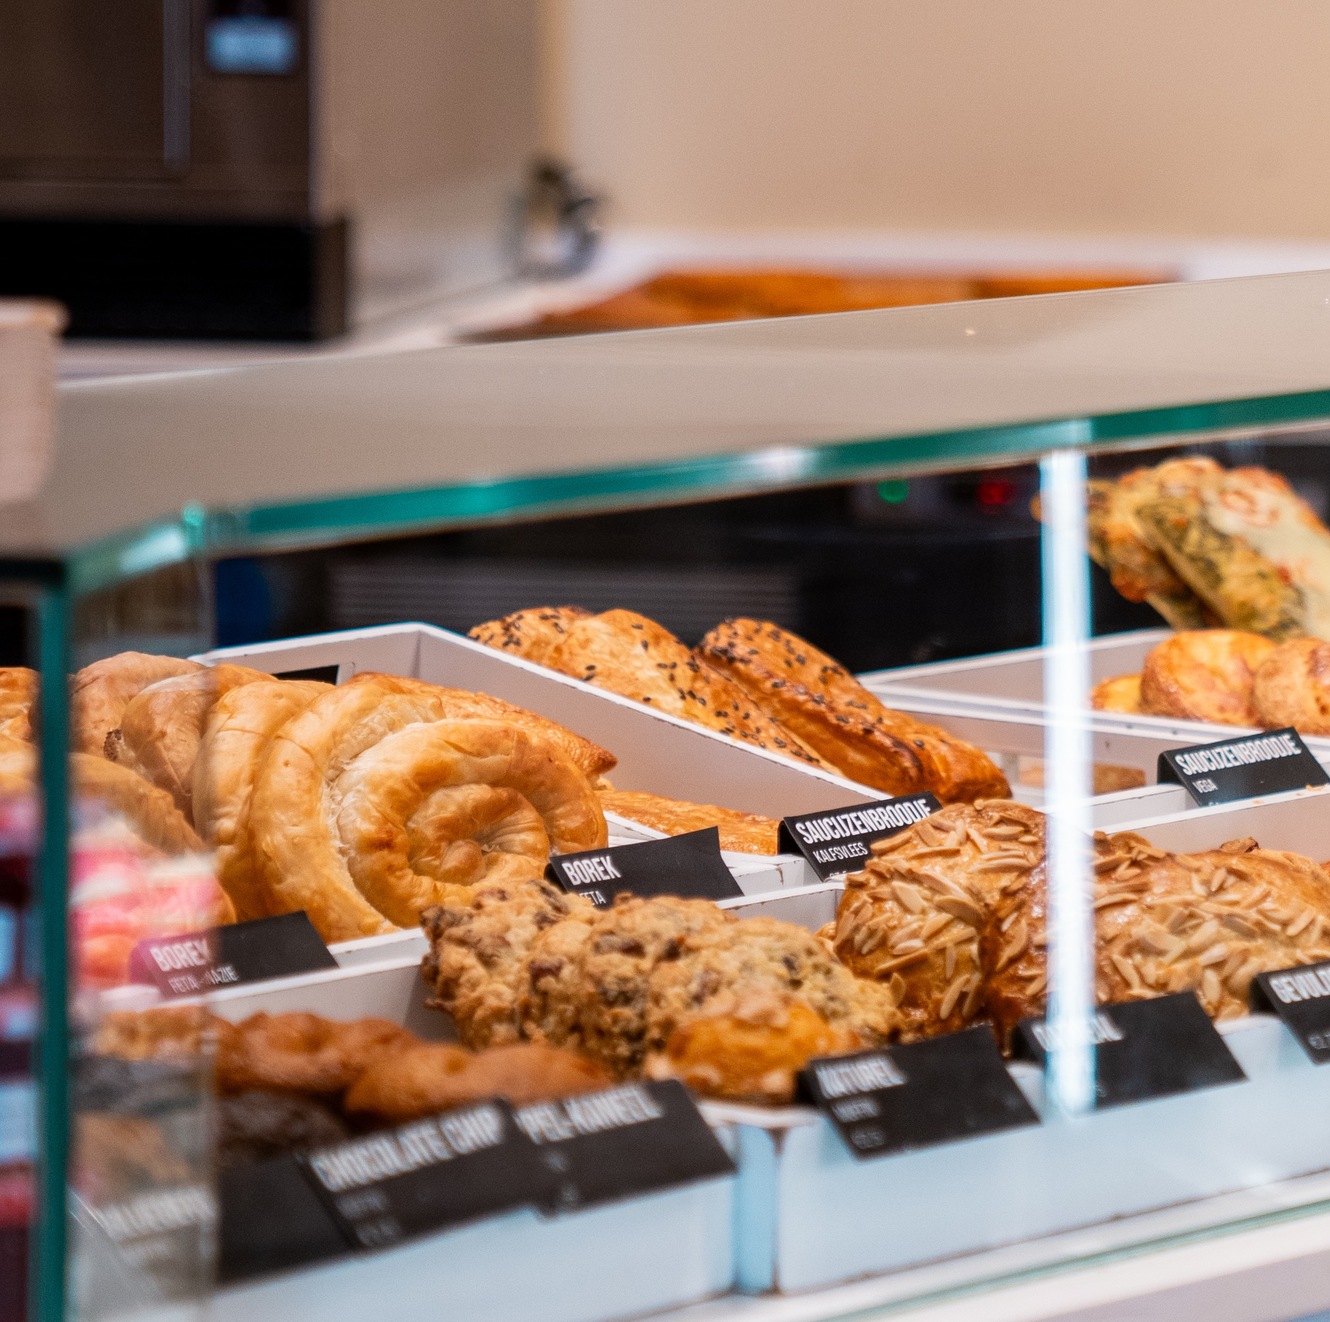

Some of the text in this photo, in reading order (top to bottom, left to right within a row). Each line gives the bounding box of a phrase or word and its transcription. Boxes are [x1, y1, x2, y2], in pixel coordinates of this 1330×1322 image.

[1174, 734, 1302, 776] SAUCIJZENBROODJE
[1192, 778, 1218, 794] VEGA
[812, 842, 868, 864] KALFSVLEES
[561, 855, 622, 886] BOREK
